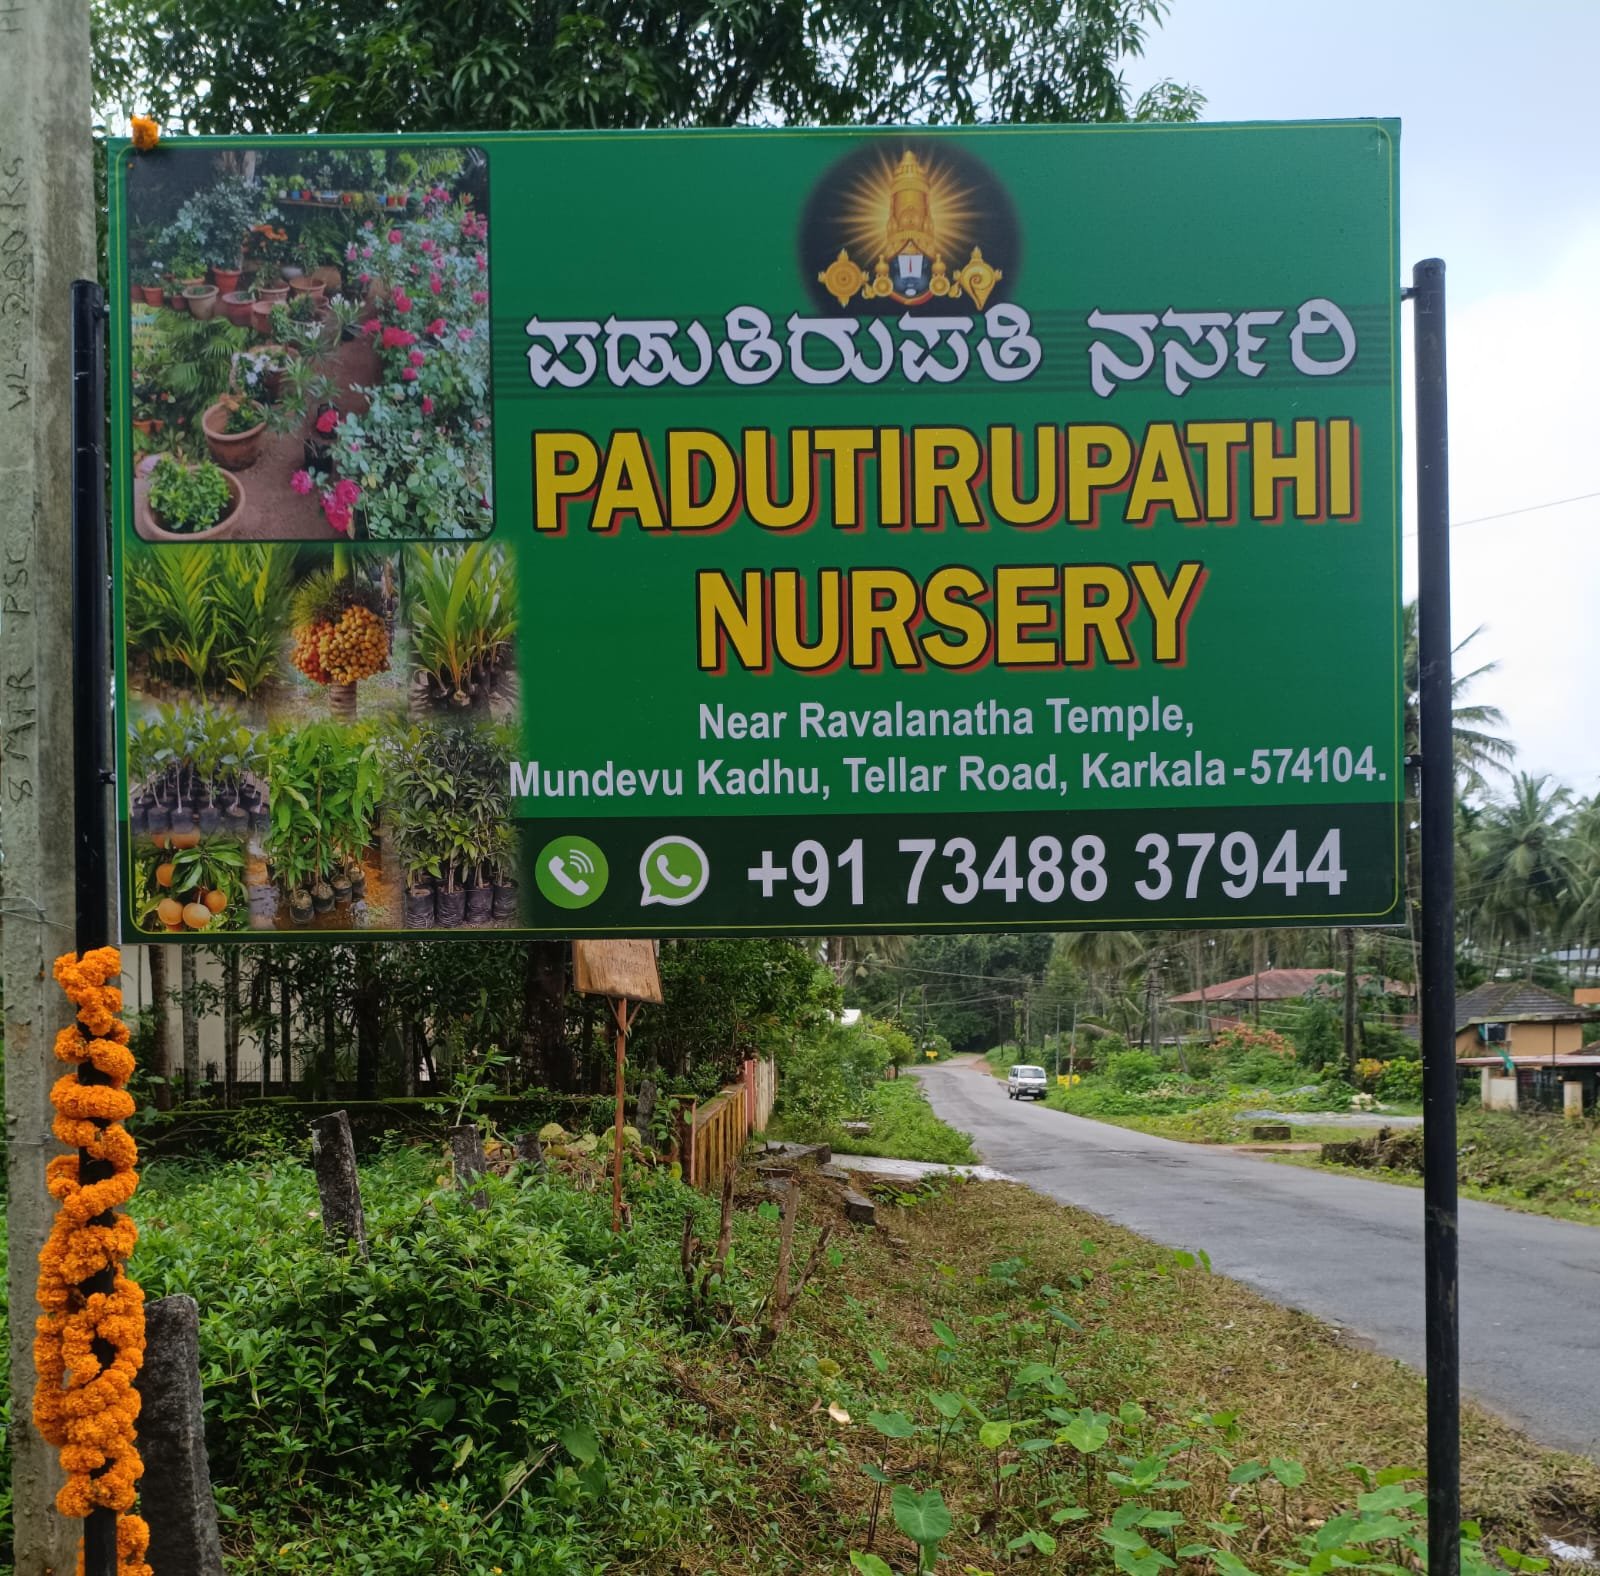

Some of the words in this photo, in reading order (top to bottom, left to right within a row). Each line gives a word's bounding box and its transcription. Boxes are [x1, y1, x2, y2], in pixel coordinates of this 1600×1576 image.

[525, 303, 1042, 389] ಪಡುತಿರುಪತಿ
[1087, 298, 1357, 397] ನರ್ಸರಿ
[533, 418, 1359, 532] PADUTIRUPATHI
[697, 562, 1206, 674] NURSERY
[699, 703, 788, 739] Near
[800, 699, 1034, 738] Ravalanatha
[1045, 695, 1193, 741] Temple,
[509, 760, 683, 797] Mundevu
[698, 758, 830, 801] Kadhu,
[842, 756, 947, 793] Tellar
[959, 754, 1067, 796] Road,
[747, 838, 864, 907] +91
[898, 834, 1108, 905] 73488
[1134, 828, 1348, 901] 37944
